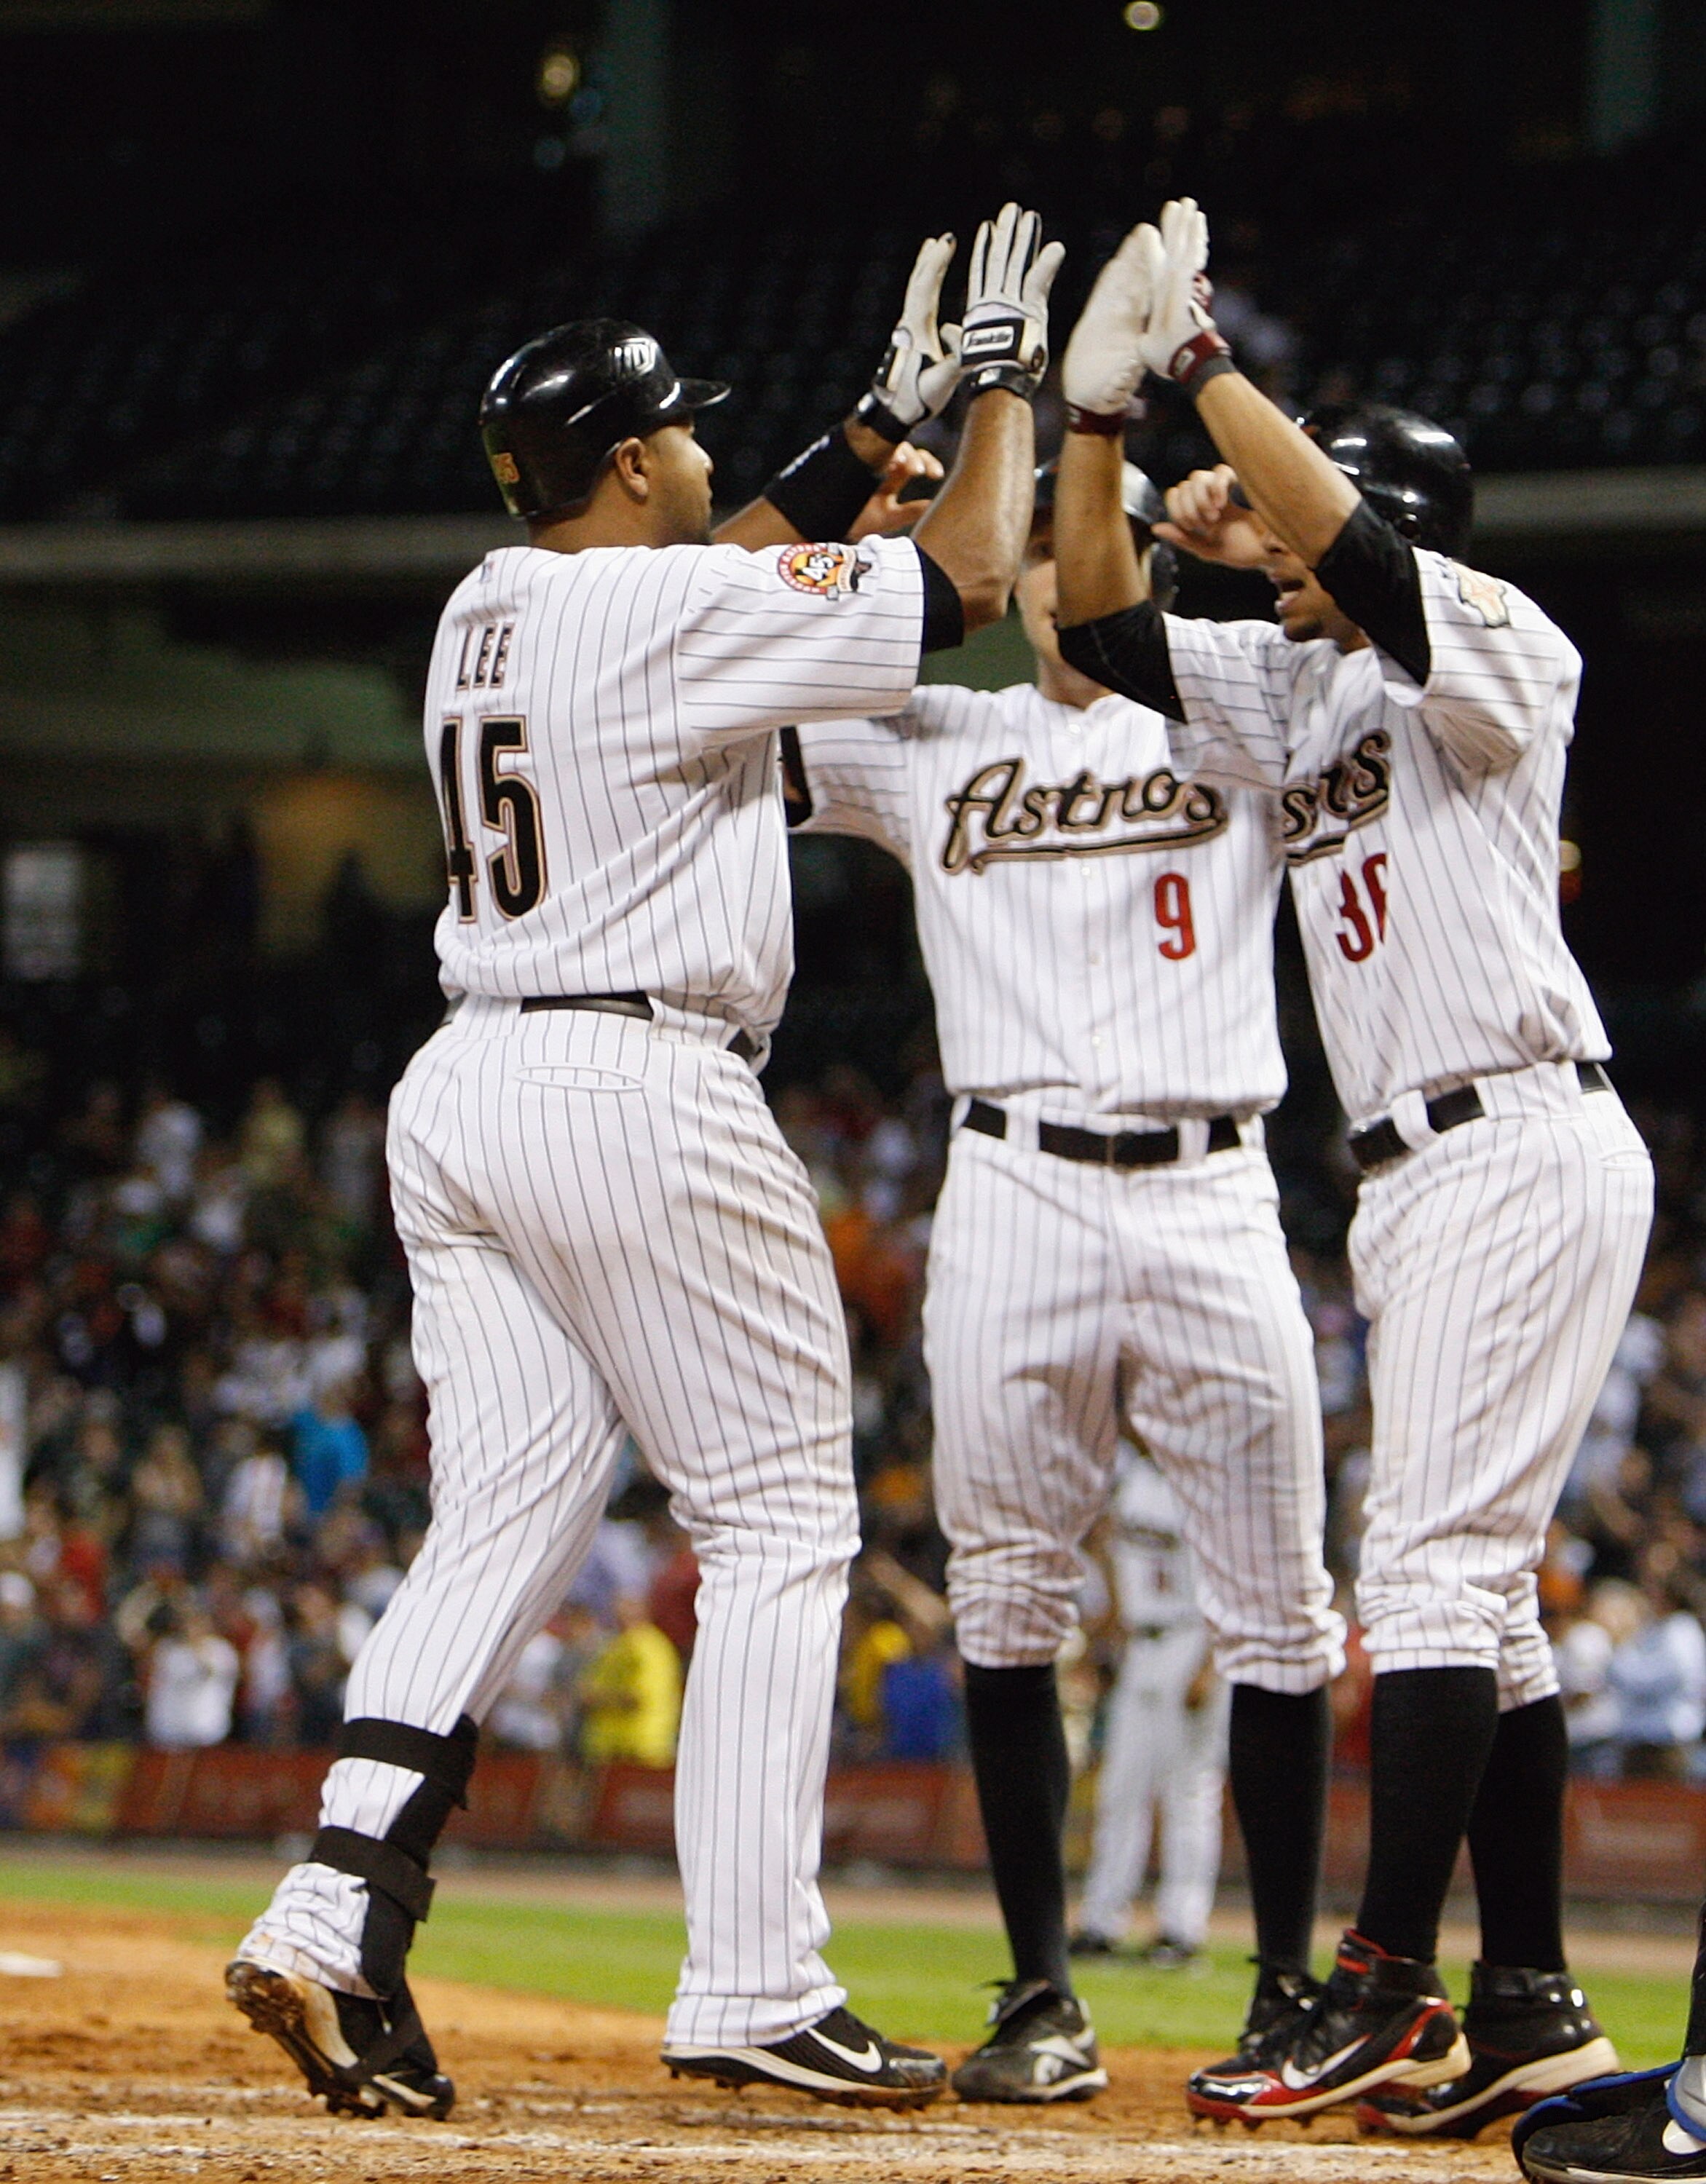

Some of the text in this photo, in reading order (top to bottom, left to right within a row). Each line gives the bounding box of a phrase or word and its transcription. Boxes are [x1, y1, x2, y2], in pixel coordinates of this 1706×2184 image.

[457, 621, 515, 690] LEE
[440, 715, 548, 924] 45
[940, 752, 1229, 875] Astros
[1153, 873, 1196, 961] 9
